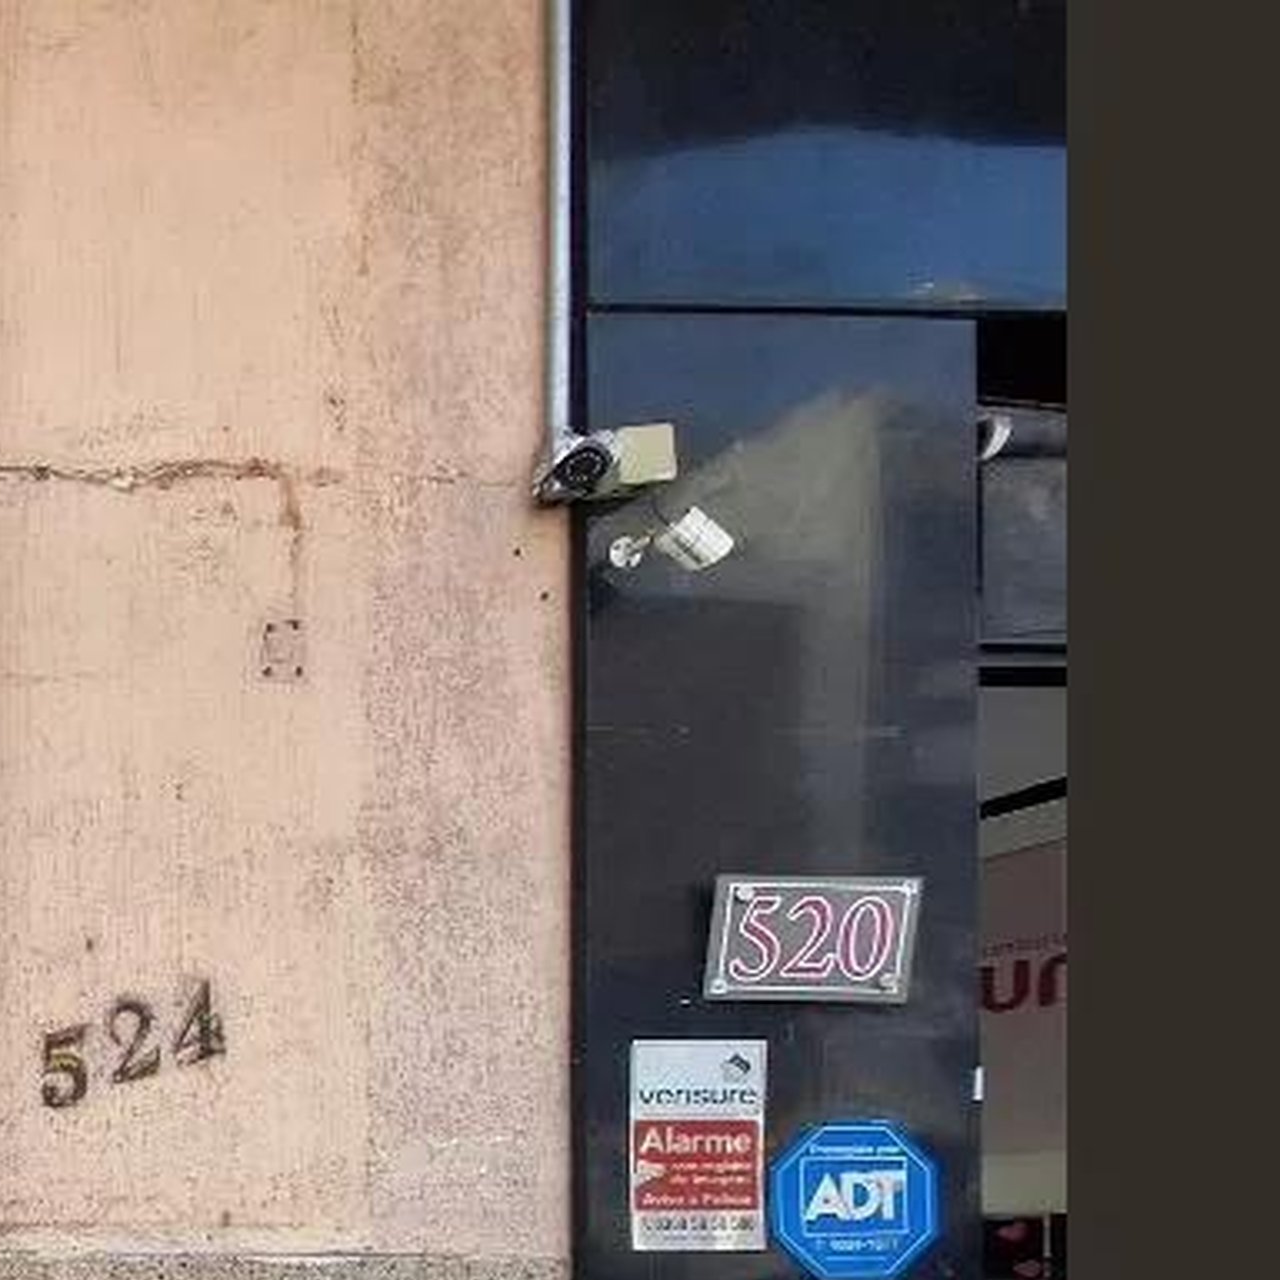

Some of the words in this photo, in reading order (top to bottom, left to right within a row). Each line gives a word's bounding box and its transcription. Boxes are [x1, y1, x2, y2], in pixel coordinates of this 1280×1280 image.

[729, 895, 895, 981] 520
[41, 978, 227, 1109] 524
[639, 1087, 758, 1105] verisure
[640, 1126, 753, 1154] Alarme
[805, 1169, 907, 1221] ADT
